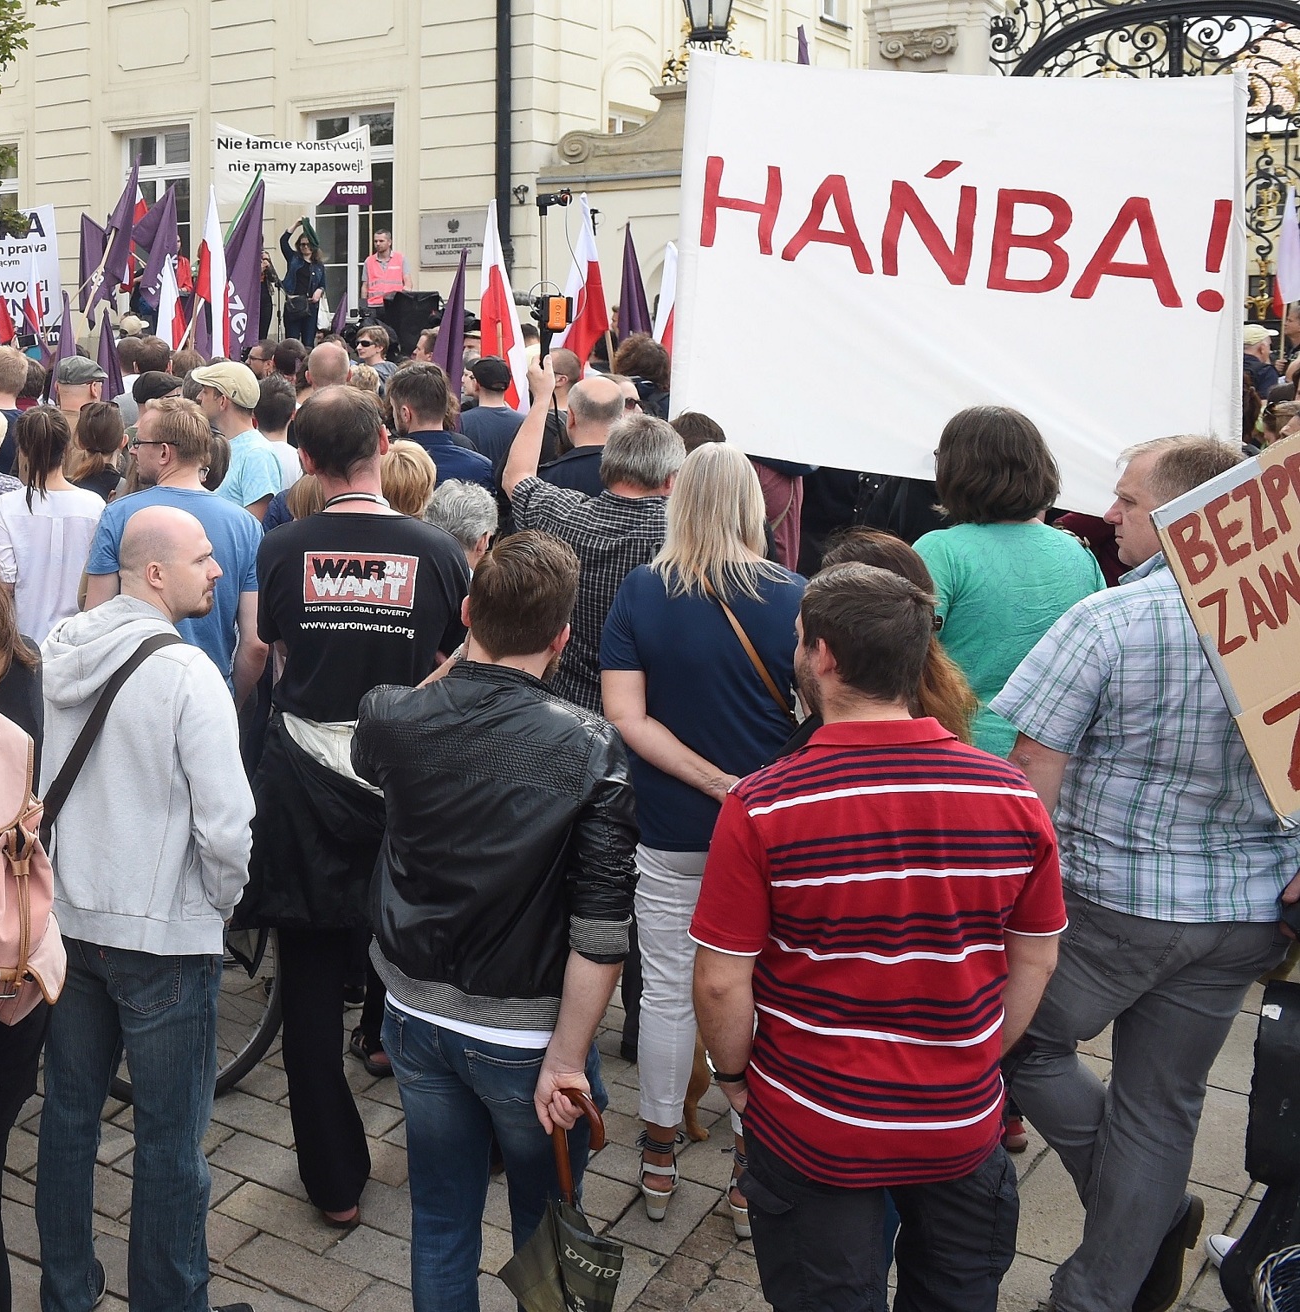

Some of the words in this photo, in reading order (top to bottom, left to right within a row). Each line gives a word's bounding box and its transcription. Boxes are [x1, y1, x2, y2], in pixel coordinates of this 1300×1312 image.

[217, 137, 242, 150] Nie
[246, 138, 292, 150] łamcie
[228, 160, 250, 172] nie
[254, 162, 296, 174] mamy
[300, 160, 364, 174] zapasowej!
[336, 184, 367, 195] razem
[699, 156, 1232, 312] HAŃBA!
[312, 557, 387, 580] WAR
[384, 560, 409, 577] ON
[311, 572, 407, 601] WANT
[1198, 546, 1300, 657] ZAW
[304, 605, 341, 613] FIGHTING
[342, 605, 375, 614] GLOBAL
[376, 608, 411, 618] POVERTY
[300, 621, 415, 639] www.waronwant.org
